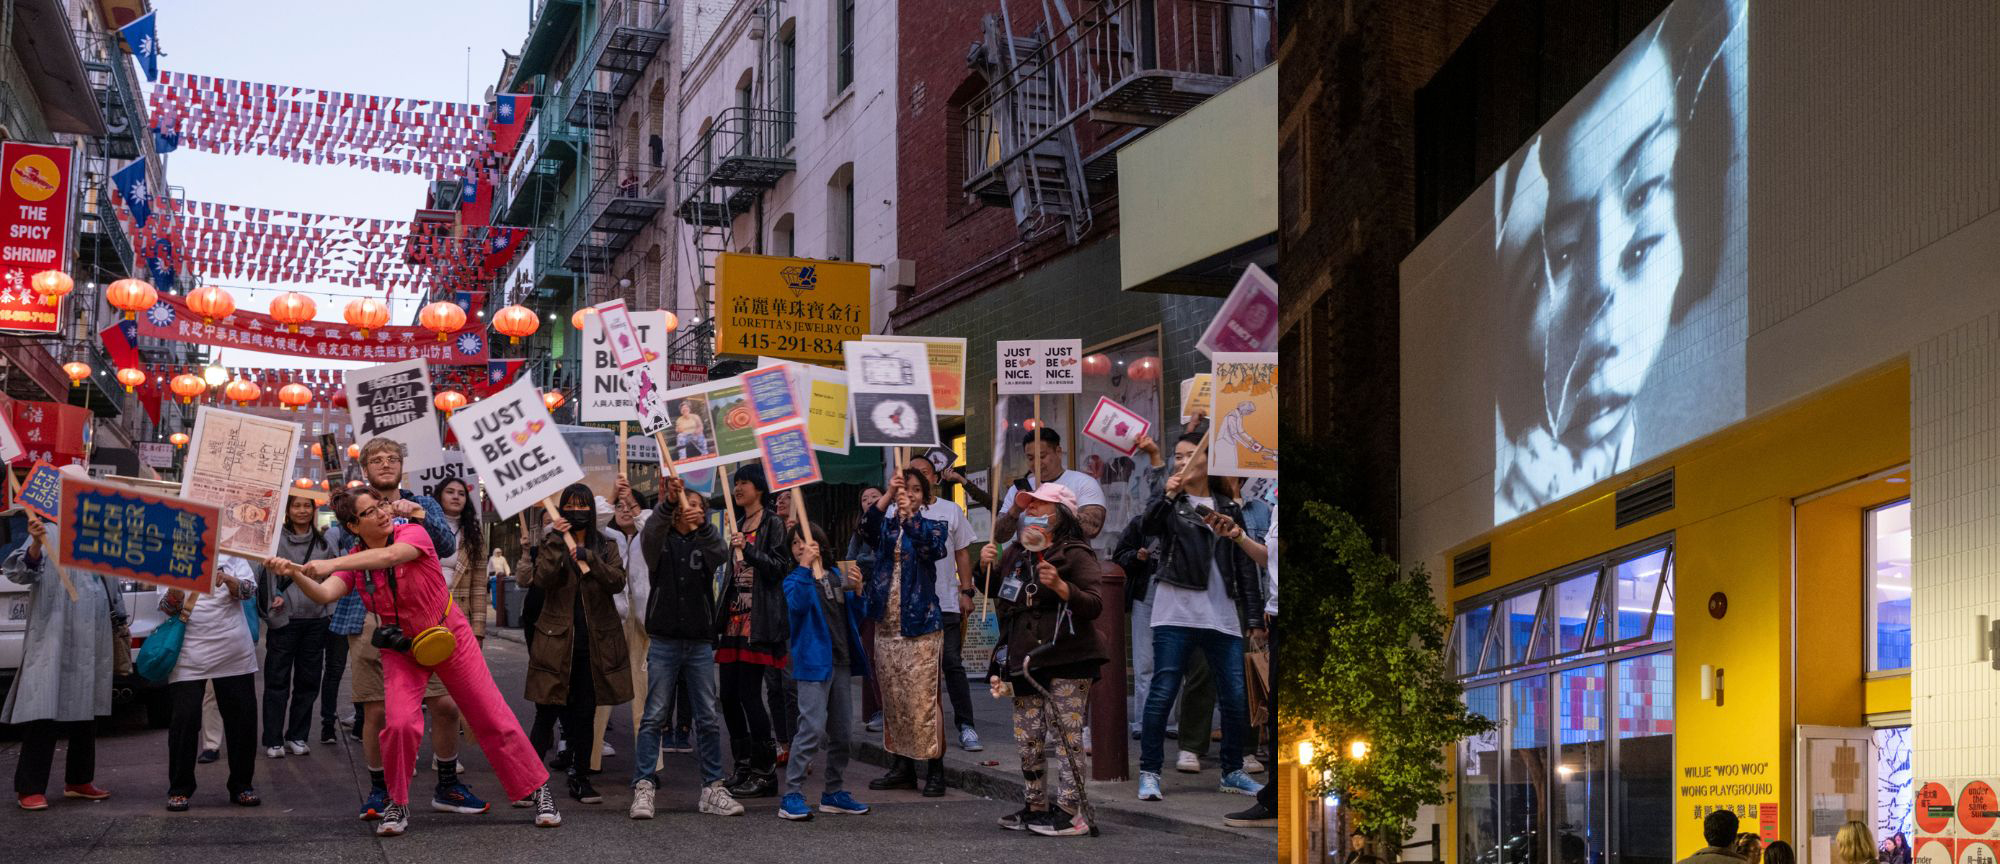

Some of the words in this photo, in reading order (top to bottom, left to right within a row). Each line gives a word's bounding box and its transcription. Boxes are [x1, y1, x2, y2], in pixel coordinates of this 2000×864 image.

[19, 205, 47, 221] THE
[10, 224, 51, 240] SPICY
[2, 246, 57, 263] SHRIMP
[732, 295, 862, 323] 富麗華珠寶金行
[593, 325, 650, 345] JT
[732, 317, 792, 332] LORETTA'S
[793, 322, 842, 336] JEWELRY
[738, 333, 843, 356] 415-291-834
[1004, 348, 1031, 357] JUST
[1045, 347, 1073, 357] JUST
[1005, 359, 1017, 368] BE
[1046, 359, 1059, 368] BE
[1005, 370, 1032, 379] NICE.
[1046, 370, 1074, 379] NICE.
[371, 385, 412, 405] AAPI
[372, 400, 416, 416] ELDER
[472, 399, 526, 440] JUST
[256, 442, 272, 472] HAPPY
[481, 435, 512, 463] BE
[270, 447, 286, 472] TIME
[493, 446, 556, 487] NICE.
[420, 463, 464, 480] JUST
[26, 470, 47, 498] LIFT
[35, 472, 55, 503] EACH
[43, 478, 62, 508] OTHE
[80, 499, 101, 554] LIFT
[103, 503, 124, 558] EACH
[125, 504, 146, 565] OTHER
[147, 524, 165, 552] UP
[690, 551, 703, 570] C
[1684, 766, 1711, 778] WILLIE
[1714, 764, 1739, 777] "WOO
[1741, 762, 1769, 775] WOO"
[1681, 785, 1708, 797] WONG
[1710, 784, 1773, 797] PLAYGROUND
[1968, 786, 1988, 796] under
[1973, 795, 1984, 804] the
[1969, 803, 1987, 811] same
